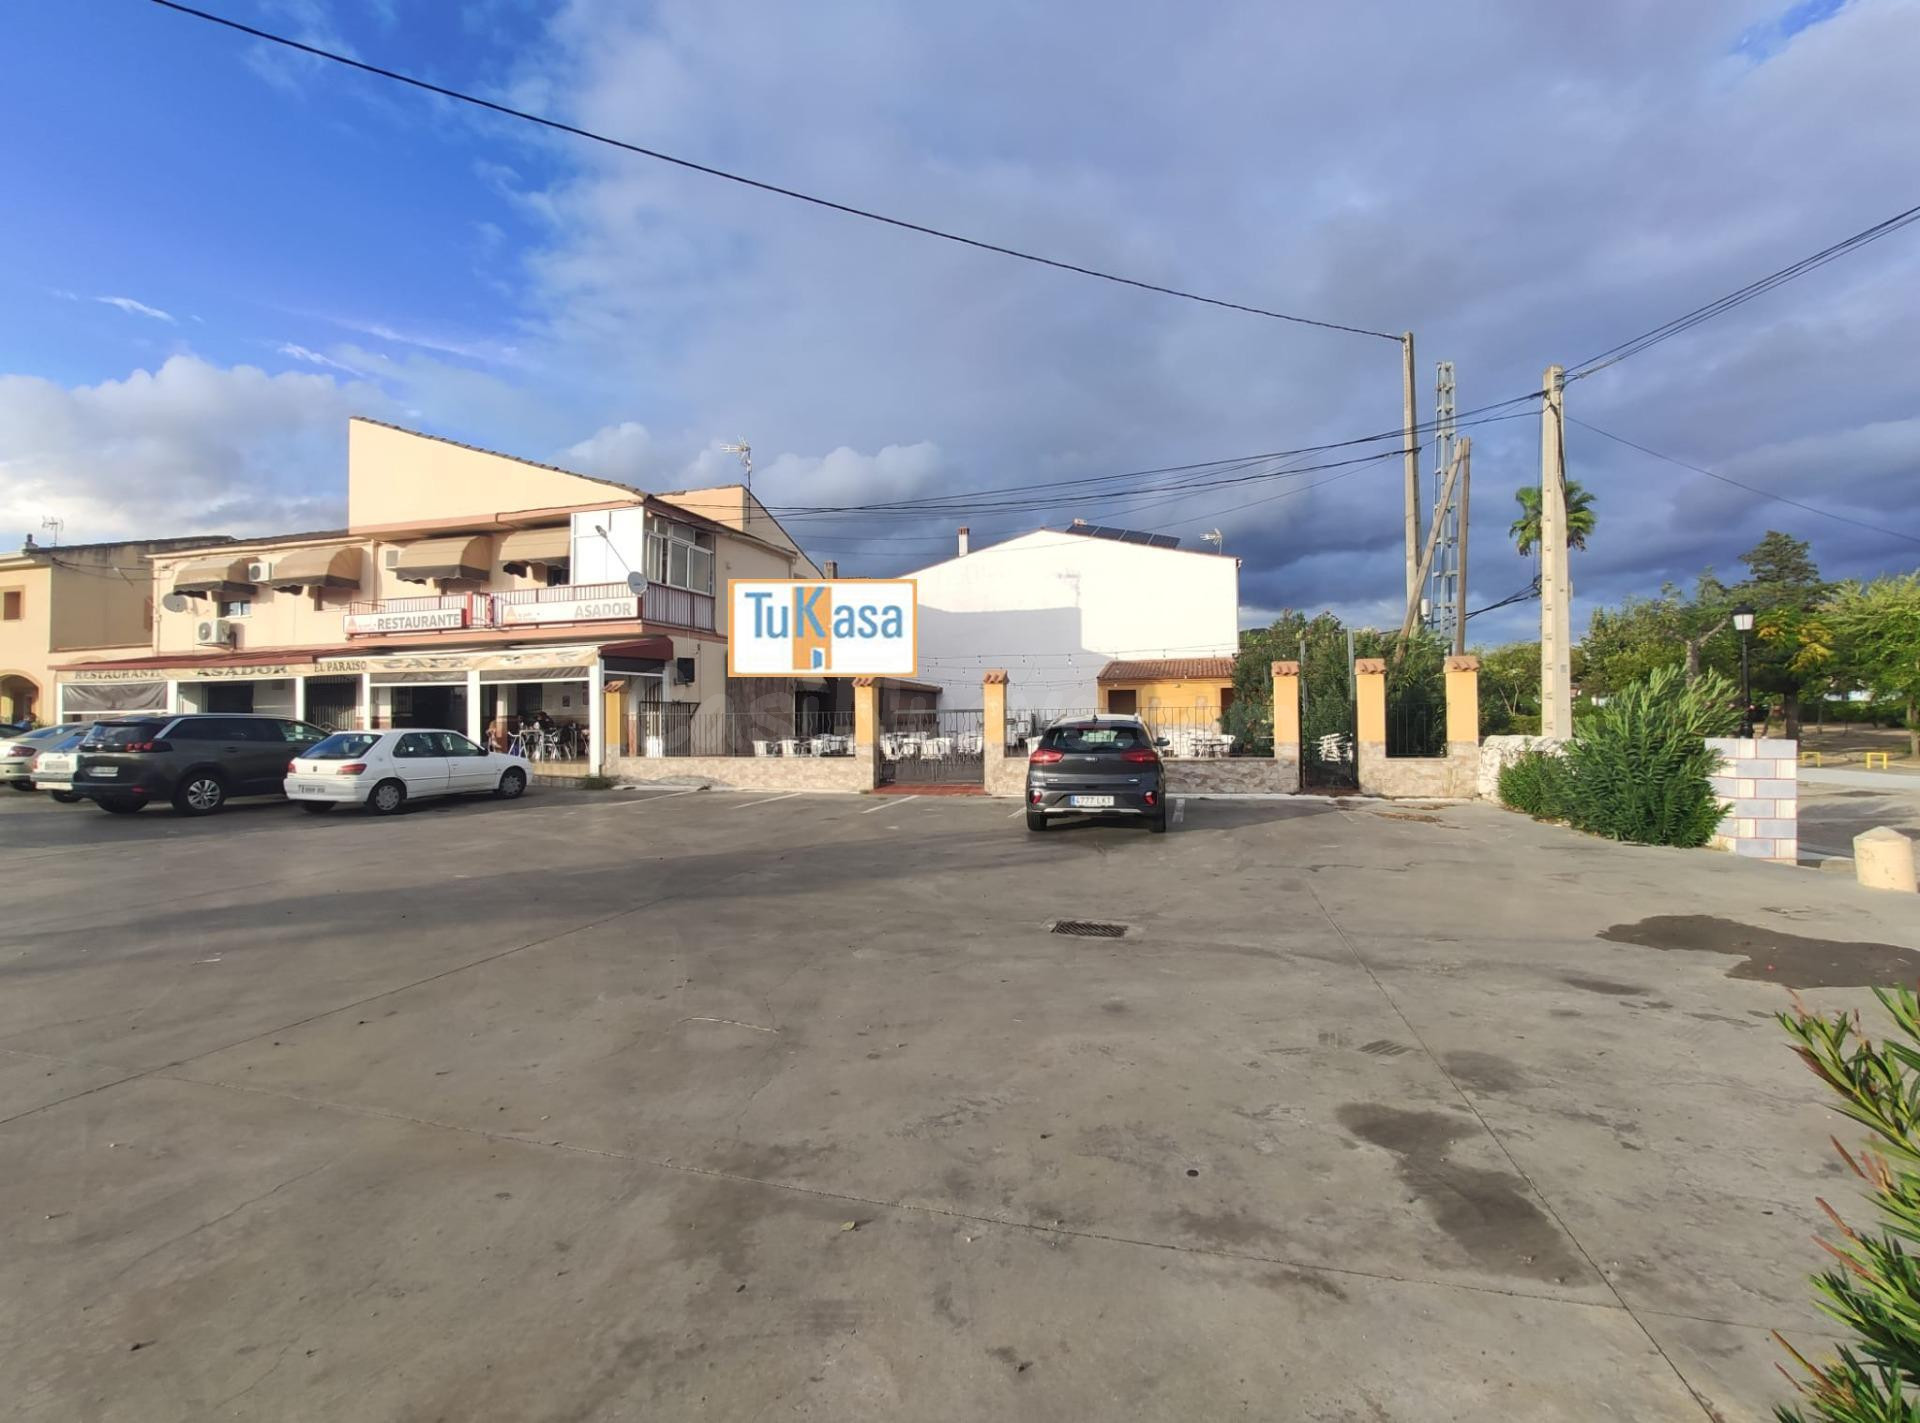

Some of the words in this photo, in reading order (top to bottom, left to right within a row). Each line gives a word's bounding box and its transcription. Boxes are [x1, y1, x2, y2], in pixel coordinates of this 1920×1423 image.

[574, 602, 633, 619] ASADOR
[377, 613, 460, 631] RESTAURANTE
[314, 662, 325, 673] EL
